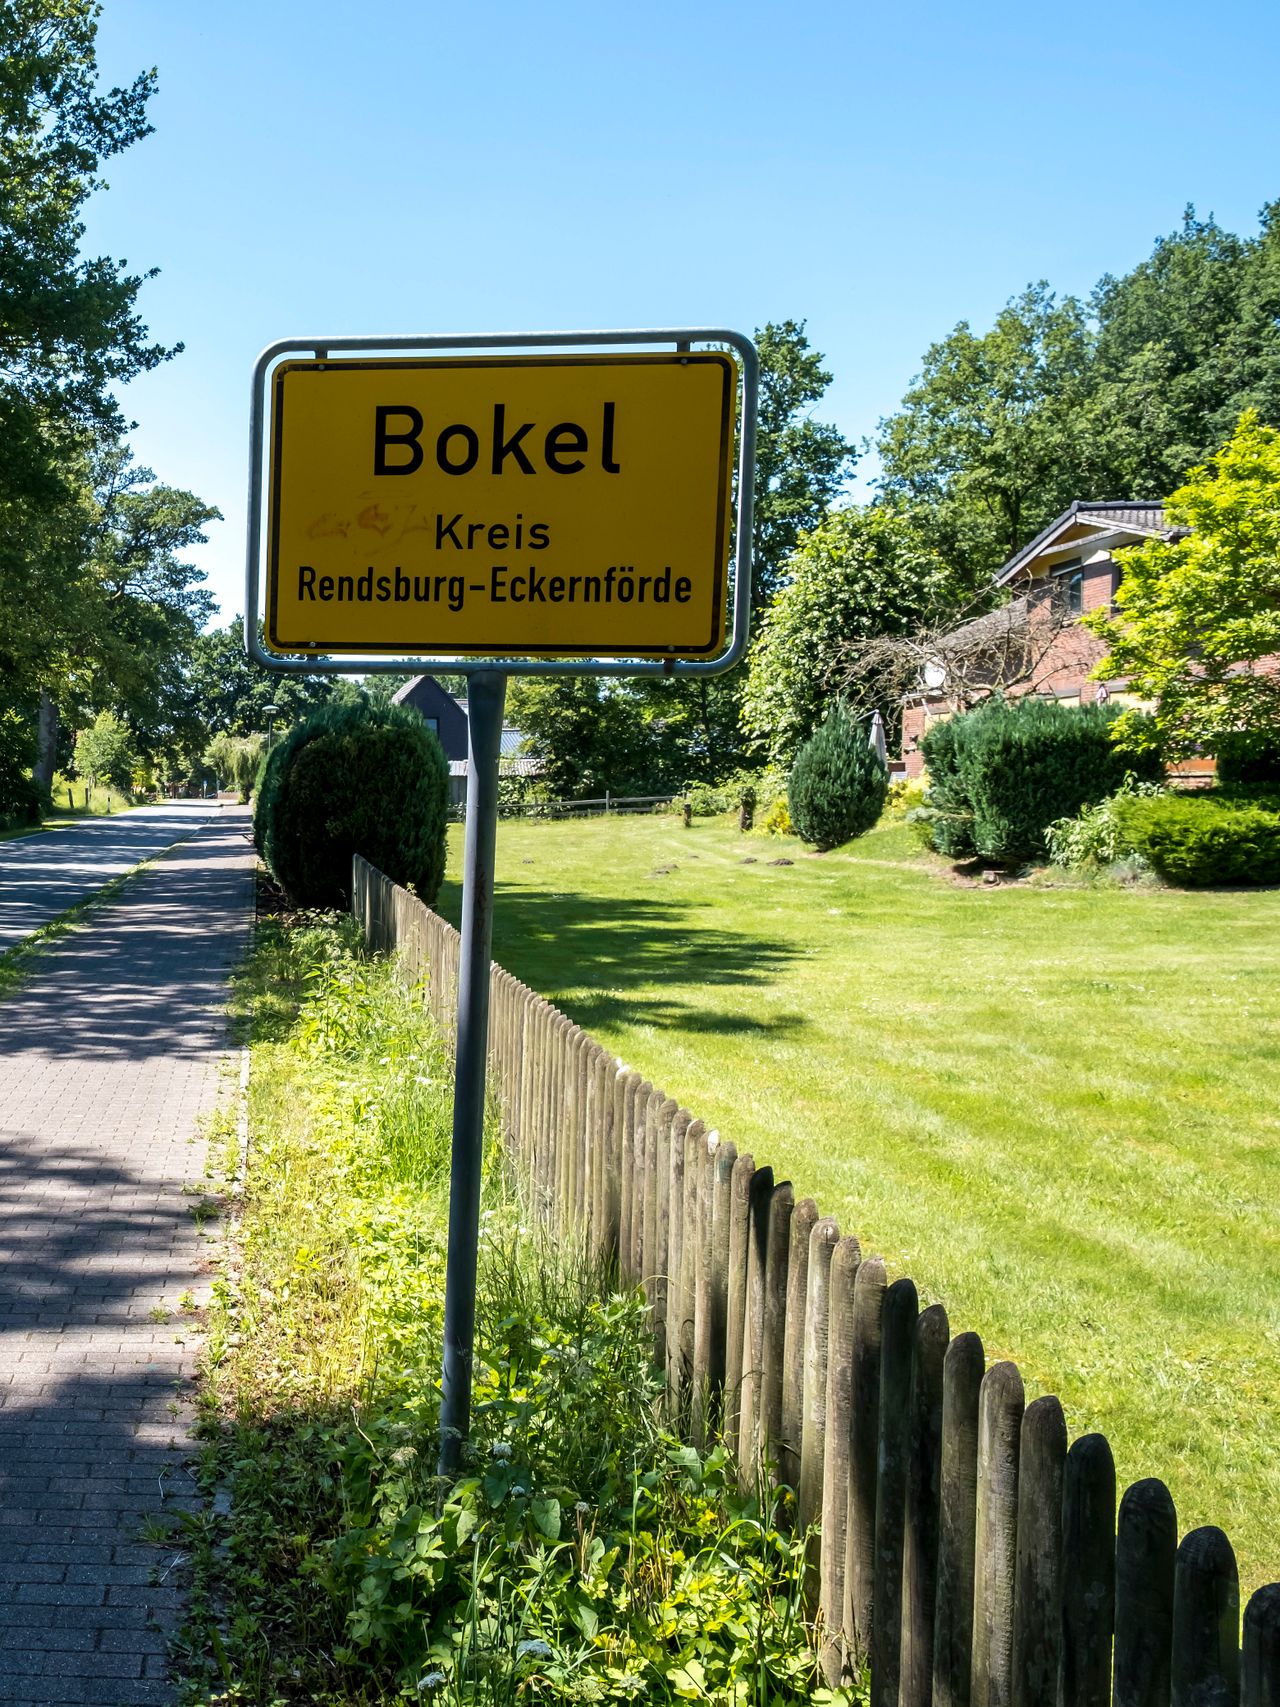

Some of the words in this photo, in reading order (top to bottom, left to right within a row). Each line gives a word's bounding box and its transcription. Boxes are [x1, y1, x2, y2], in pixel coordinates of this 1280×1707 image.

[373, 401, 621, 477] Bokel
[435, 513, 550, 550] Kreis
[298, 565, 692, 613] Rendsburg-Eckernförde
